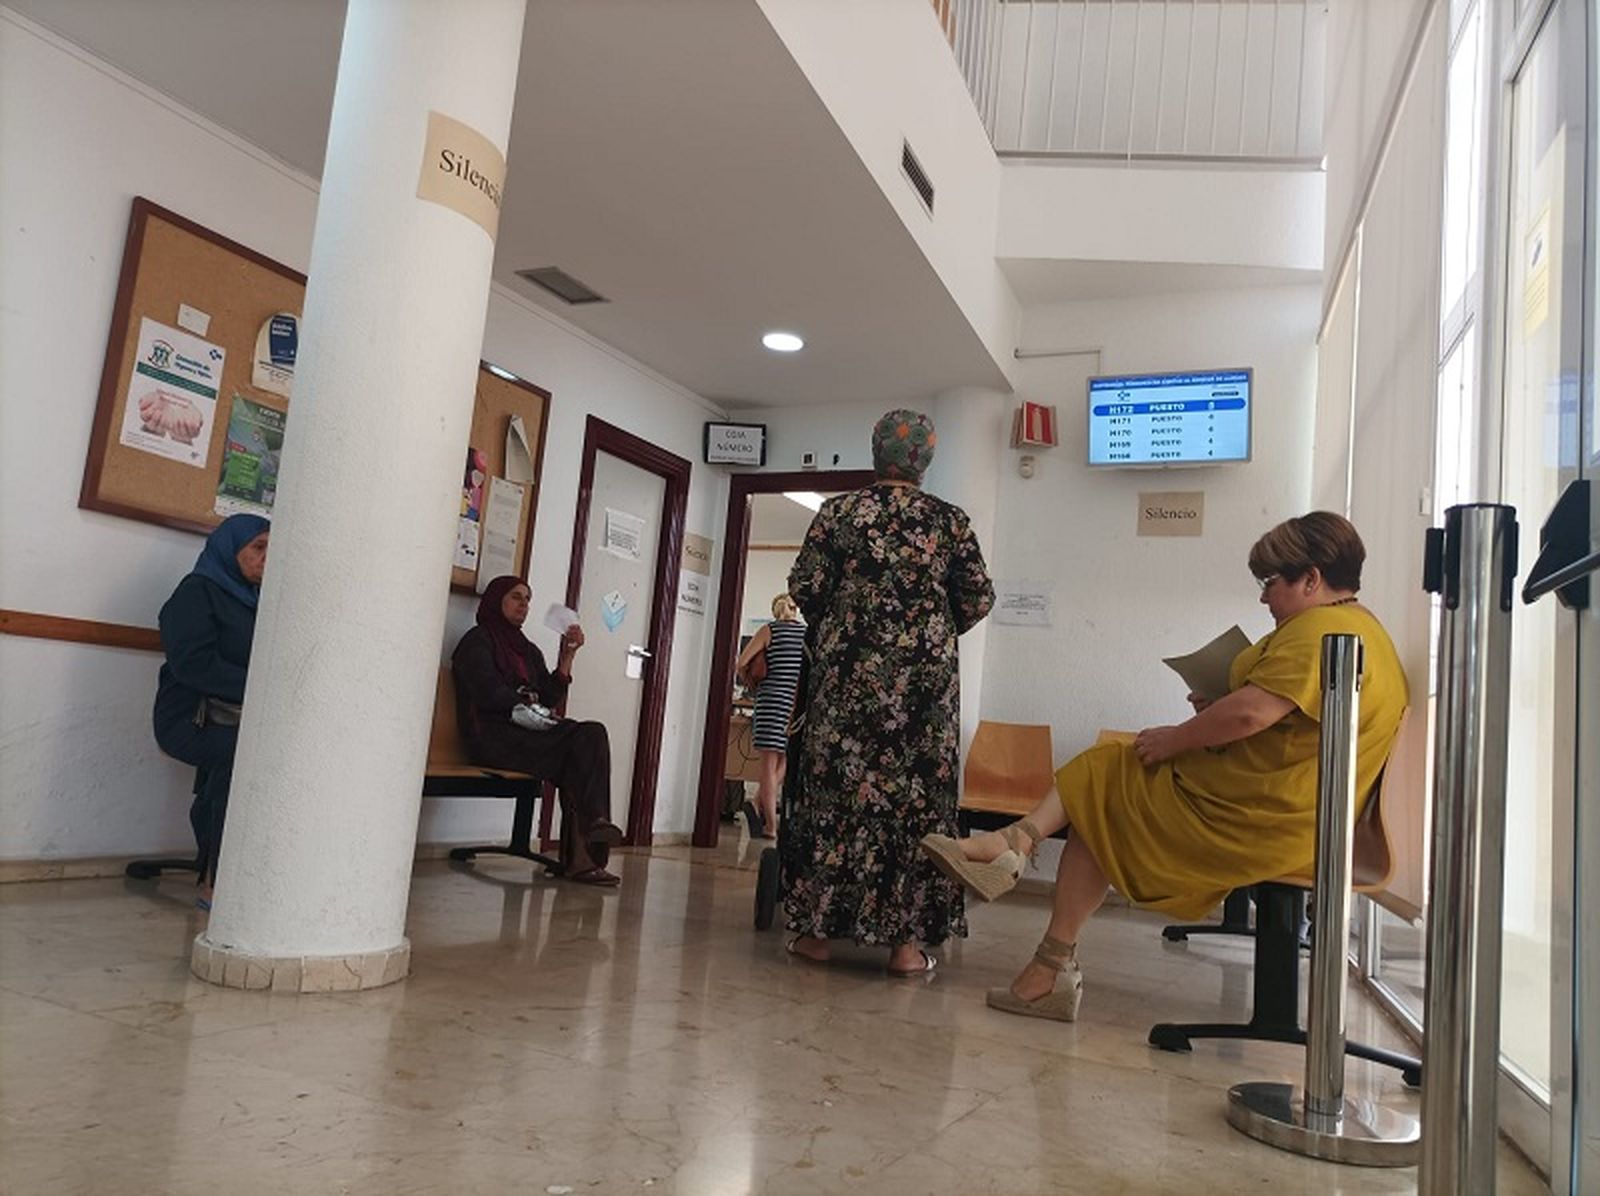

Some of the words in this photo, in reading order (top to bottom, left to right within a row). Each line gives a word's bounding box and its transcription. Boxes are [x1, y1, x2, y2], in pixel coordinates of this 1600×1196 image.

[1109, 405, 1134, 414] H172
[1149, 403, 1185, 412] PUESTO
[1151, 415, 1183, 423] PUESTO
[1151, 427, 1183, 435] PUESTO
[1151, 439, 1182, 447] PUESTO
[1150, 451, 1181, 459] PUESTO
[1145, 507, 1197, 520] Silencio
